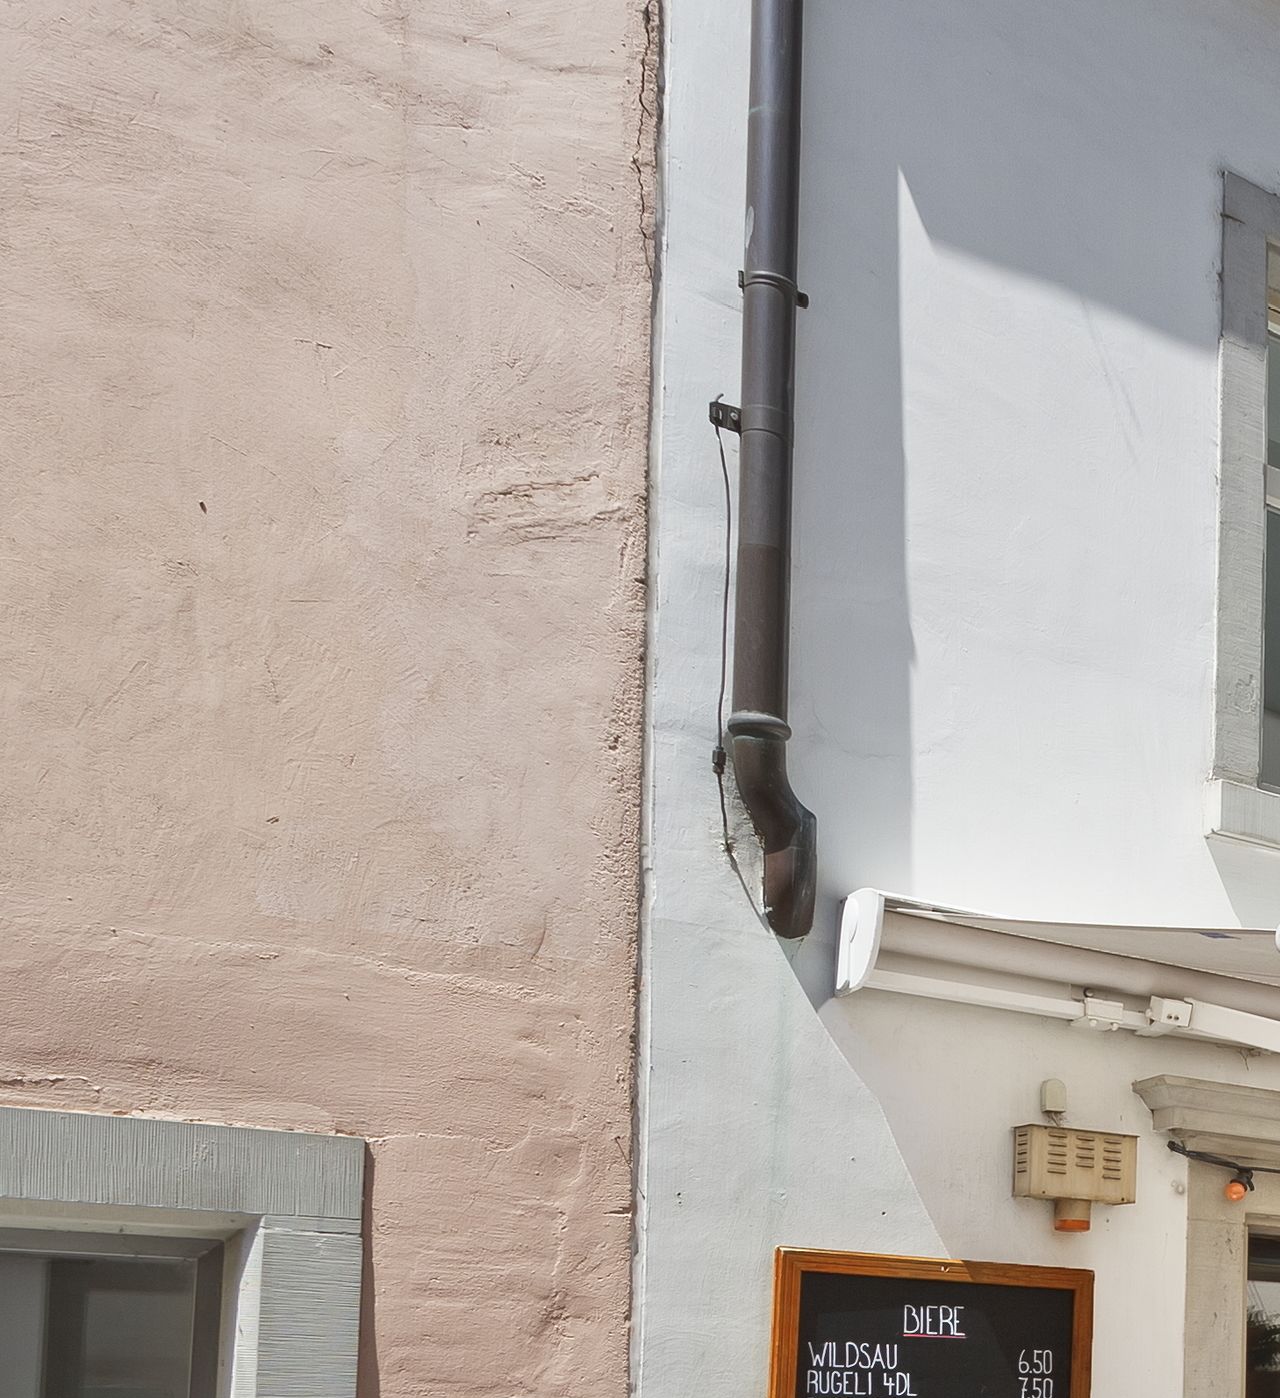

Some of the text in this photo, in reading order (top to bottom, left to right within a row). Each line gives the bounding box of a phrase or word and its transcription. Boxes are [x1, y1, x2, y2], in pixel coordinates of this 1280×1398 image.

[904, 1305, 966, 1336] BIERE
[807, 1341, 1053, 1374] WILDSAU 6.50
[806, 1370, 872, 1395] RUGELI
